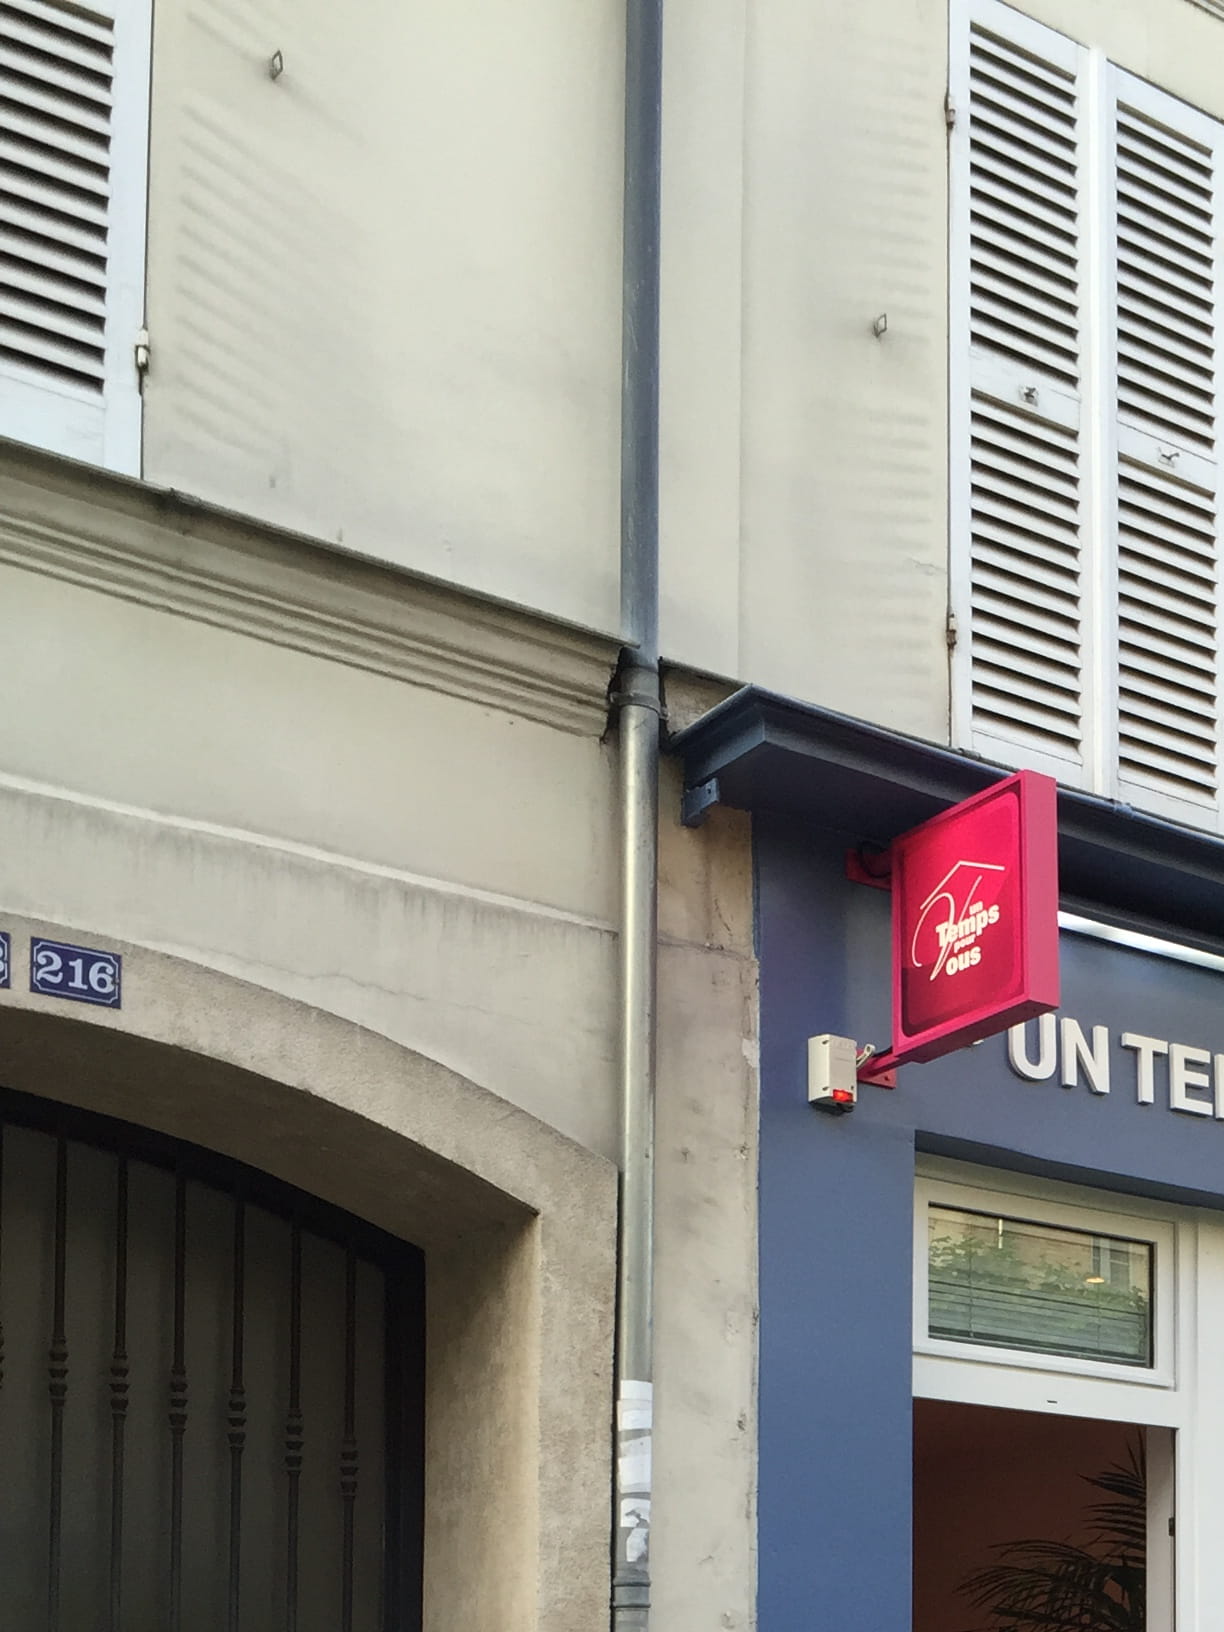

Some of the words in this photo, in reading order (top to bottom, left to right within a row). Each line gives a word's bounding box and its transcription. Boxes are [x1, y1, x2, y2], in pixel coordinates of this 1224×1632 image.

[935, 904, 999, 947] Temps
[36, 950, 115, 994] 216
[1008, 1013, 1110, 1095] UN
